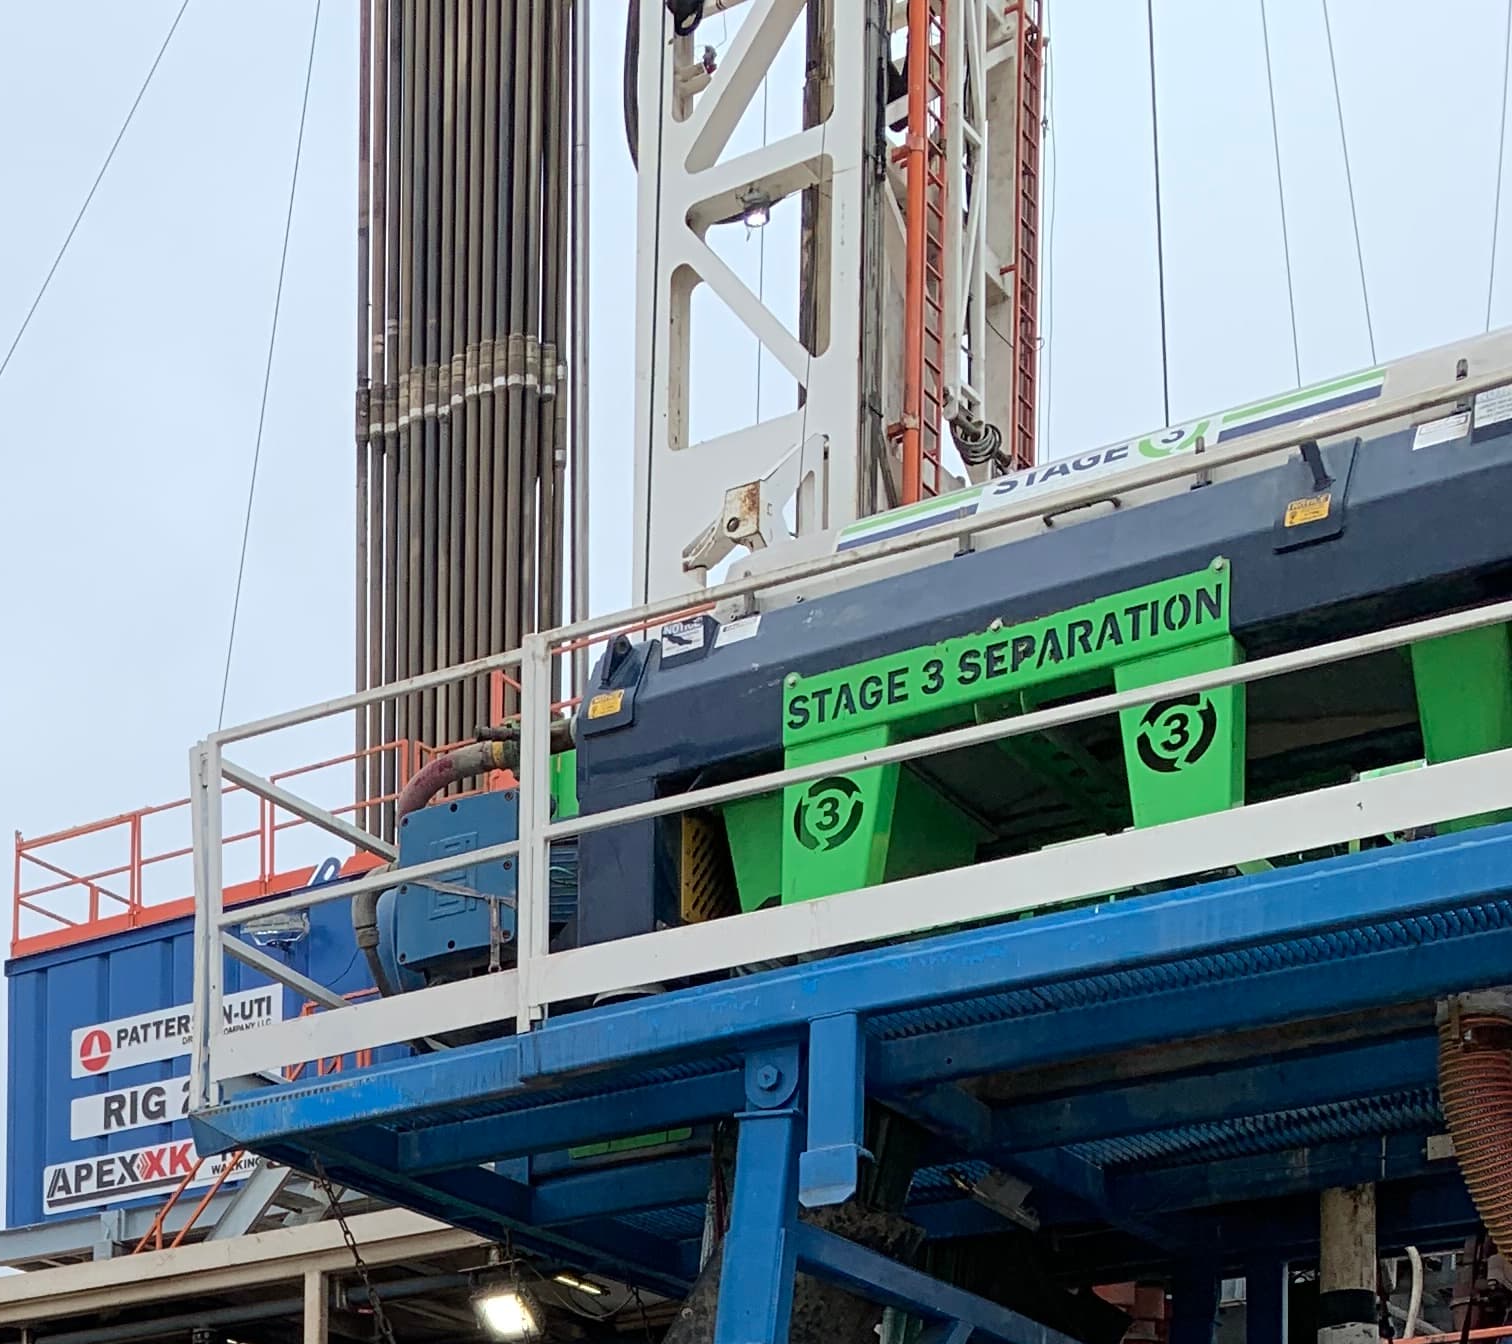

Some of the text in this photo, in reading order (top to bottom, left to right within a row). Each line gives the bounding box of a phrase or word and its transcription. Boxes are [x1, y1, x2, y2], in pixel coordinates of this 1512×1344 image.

[787, 583, 1222, 730] STAGE 3 SEPARATION
[1160, 712, 1190, 752] 3
[815, 796, 839, 831] 3
[223, 1023, 255, 1035] OMPANY
[103, 1086, 167, 1131] RIG
